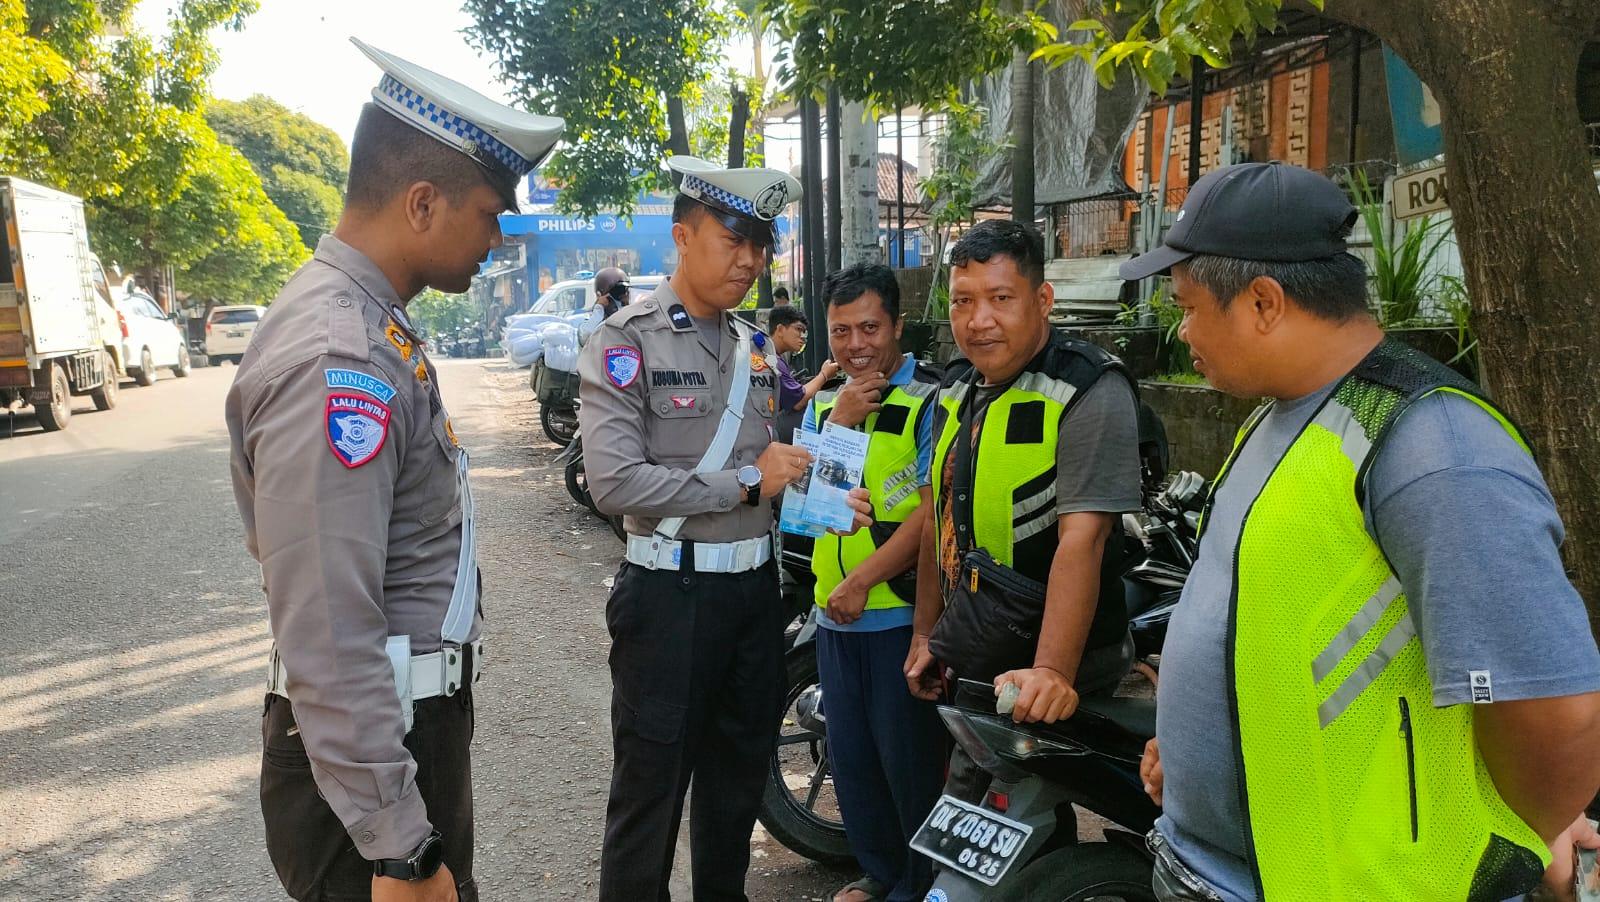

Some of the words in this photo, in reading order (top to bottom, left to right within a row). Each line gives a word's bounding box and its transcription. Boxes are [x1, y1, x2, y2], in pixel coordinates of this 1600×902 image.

[539, 219, 596, 231] PHILIPS
[330, 372, 389, 400] MINUSCA
[682, 371, 707, 386] PUTRA
[332, 398, 358, 408] LALU
[358, 400, 387, 420] LINTAS
[951, 812, 998, 849] 4068
[990, 827, 1022, 858] SU
